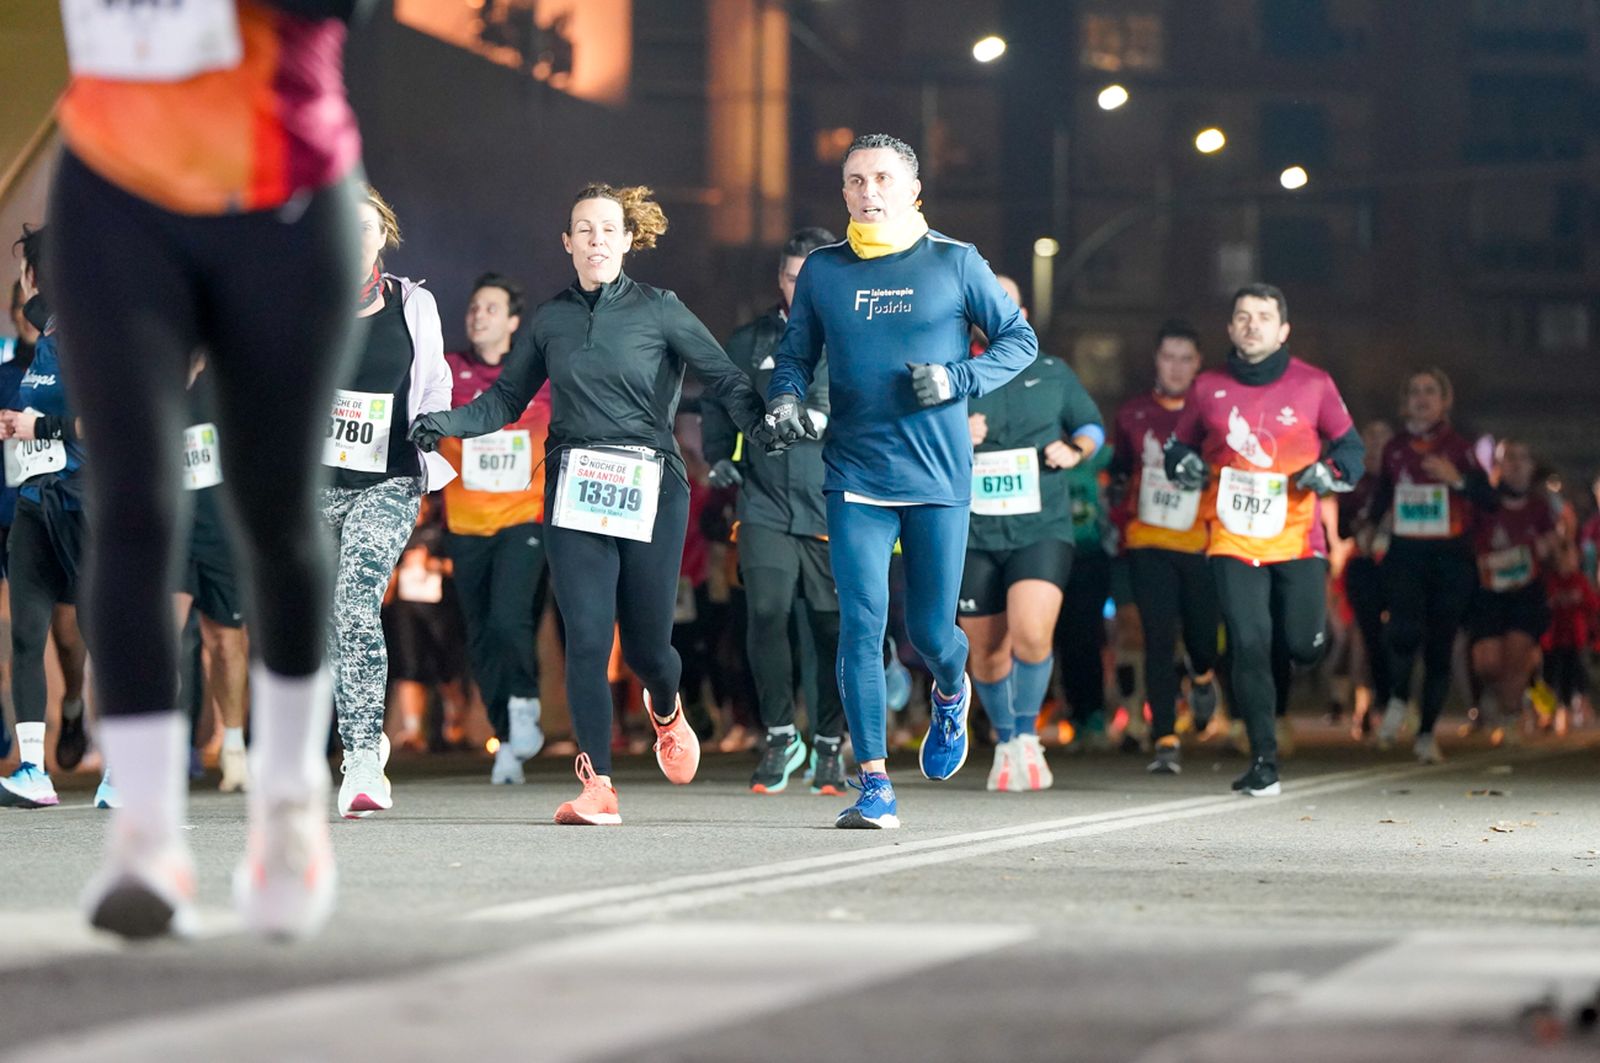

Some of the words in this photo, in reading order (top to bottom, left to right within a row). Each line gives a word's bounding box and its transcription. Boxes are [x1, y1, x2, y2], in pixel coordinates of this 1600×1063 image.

[332, 407, 362, 418] ANTON
[352, 401, 362, 409] DE
[479, 454, 516, 470] 6077
[589, 460, 615, 473] NOCHE
[616, 465, 628, 474] DE
[576, 468, 597, 479] SAN
[596, 472, 626, 485] ANTON
[982, 474, 1022, 493] 6791
[578, 479, 642, 512] 13319
[1232, 493, 1272, 515] 6792
